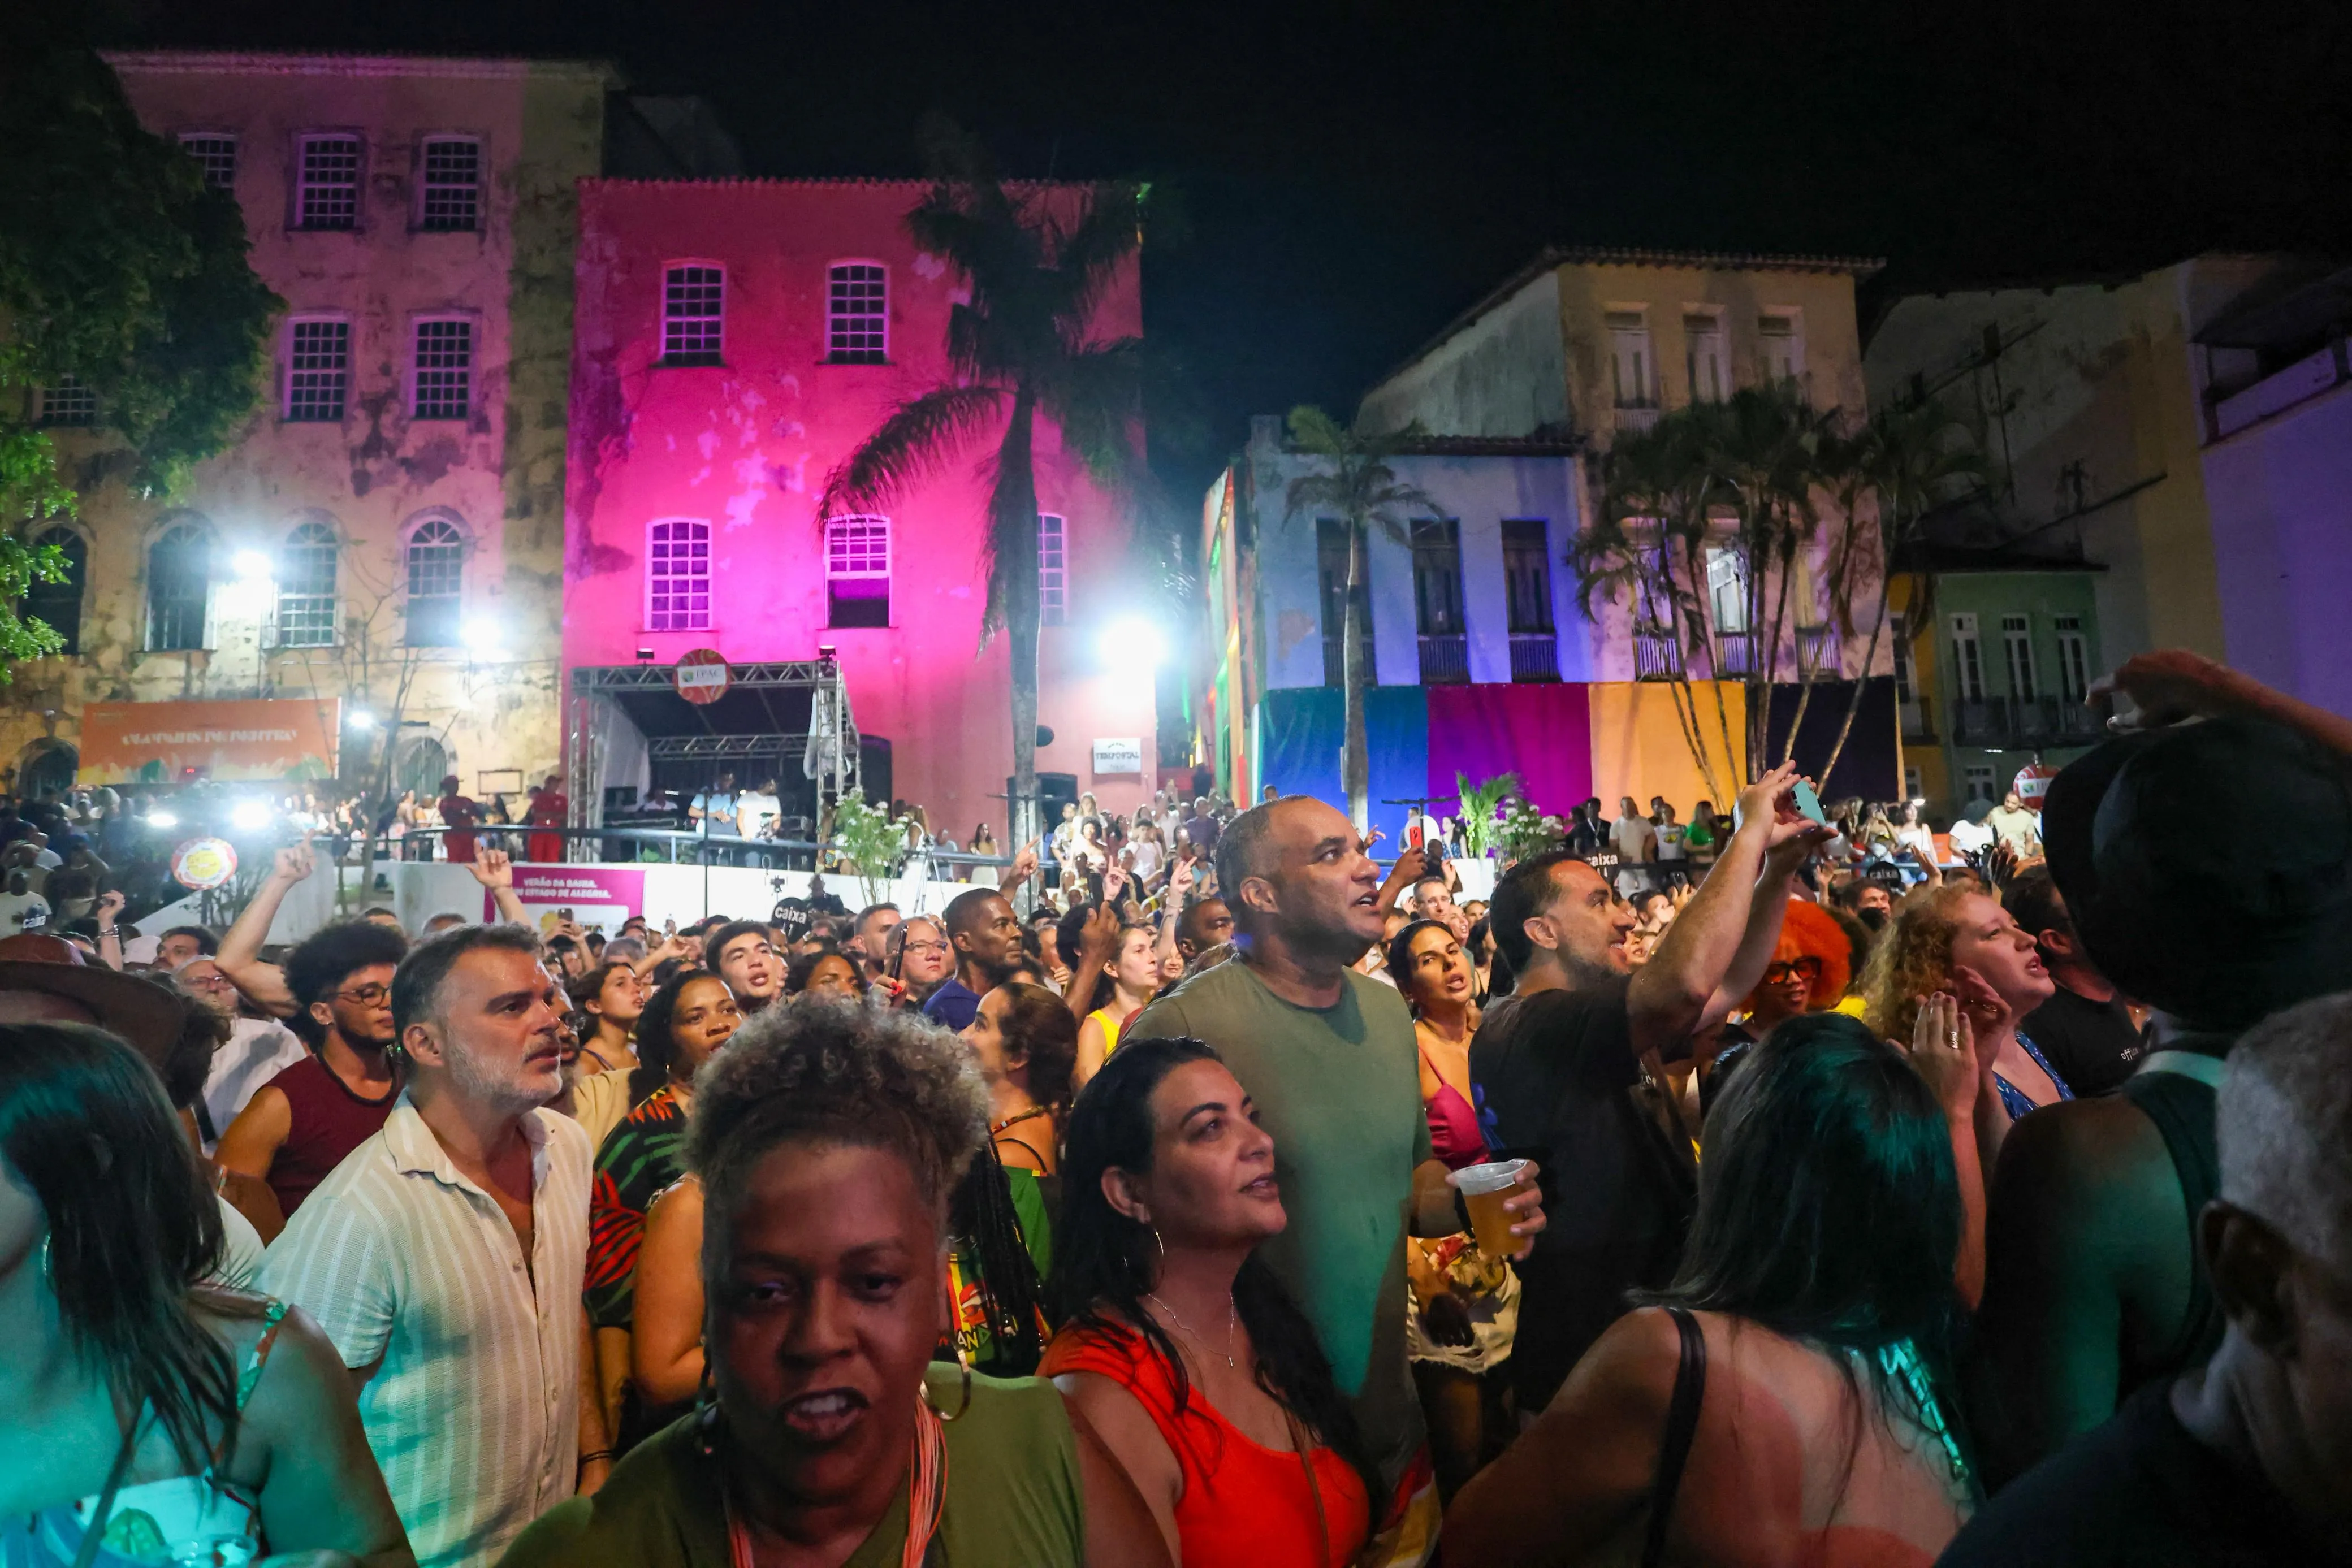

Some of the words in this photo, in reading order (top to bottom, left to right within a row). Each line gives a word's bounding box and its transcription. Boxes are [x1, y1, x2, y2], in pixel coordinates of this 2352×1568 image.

[1096, 751, 1139, 760] TEMPOSTAL
[524, 876, 552, 887] VERÃO
[775, 906, 807, 924] caixa
